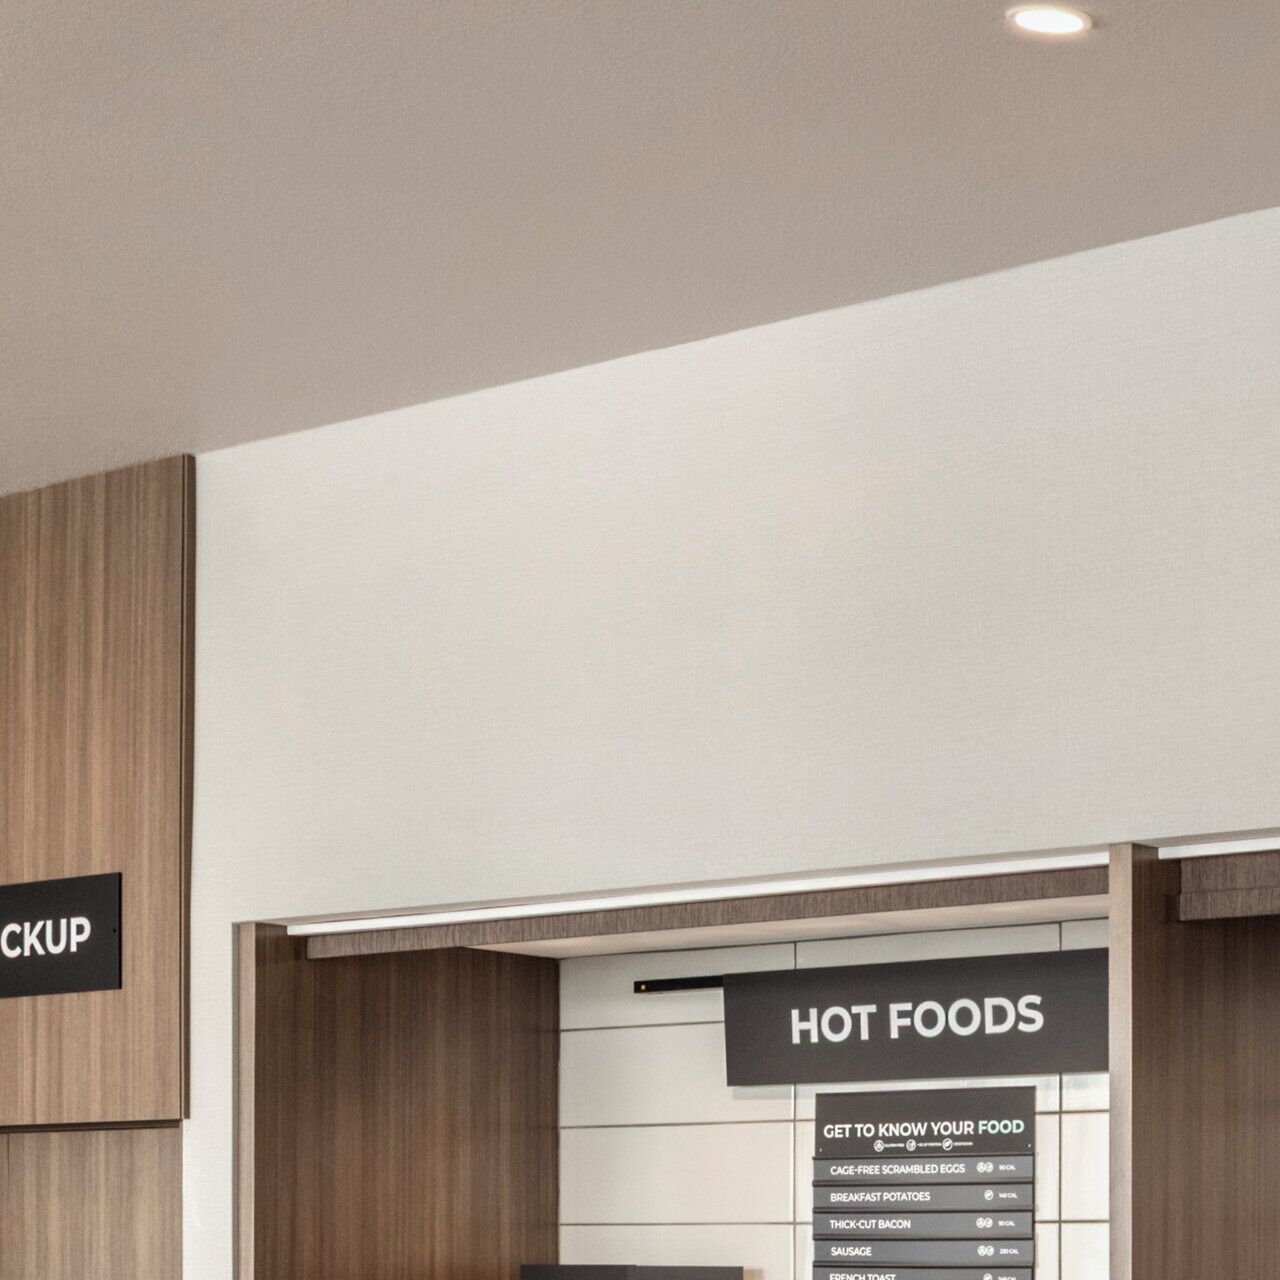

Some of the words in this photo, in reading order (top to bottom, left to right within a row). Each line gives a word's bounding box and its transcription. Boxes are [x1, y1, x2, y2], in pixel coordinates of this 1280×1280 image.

[792, 1005, 876, 1044] HOT
[890, 995, 1044, 1039] FOODS
[824, 1124, 852, 1138] GET
[855, 1124, 875, 1137] TO
[879, 1122, 927, 1136] KNOW
[931, 1121, 974, 1135] YOUR
[979, 1120, 1024, 1134] FOOD
[831, 1165, 880, 1175] CAGE-FREE
[882, 1164, 938, 1174] SCRAMBLED
[940, 1164, 965, 1173] EGGS
[831, 1192, 881, 1202] BREAKFAST
[883, 1192, 930, 1201] POTATOES
[830, 1220, 876, 1229] THICK-CUT
[878, 1220, 911, 1228] BACON
[831, 1247, 872, 1256] SAUSAGE
